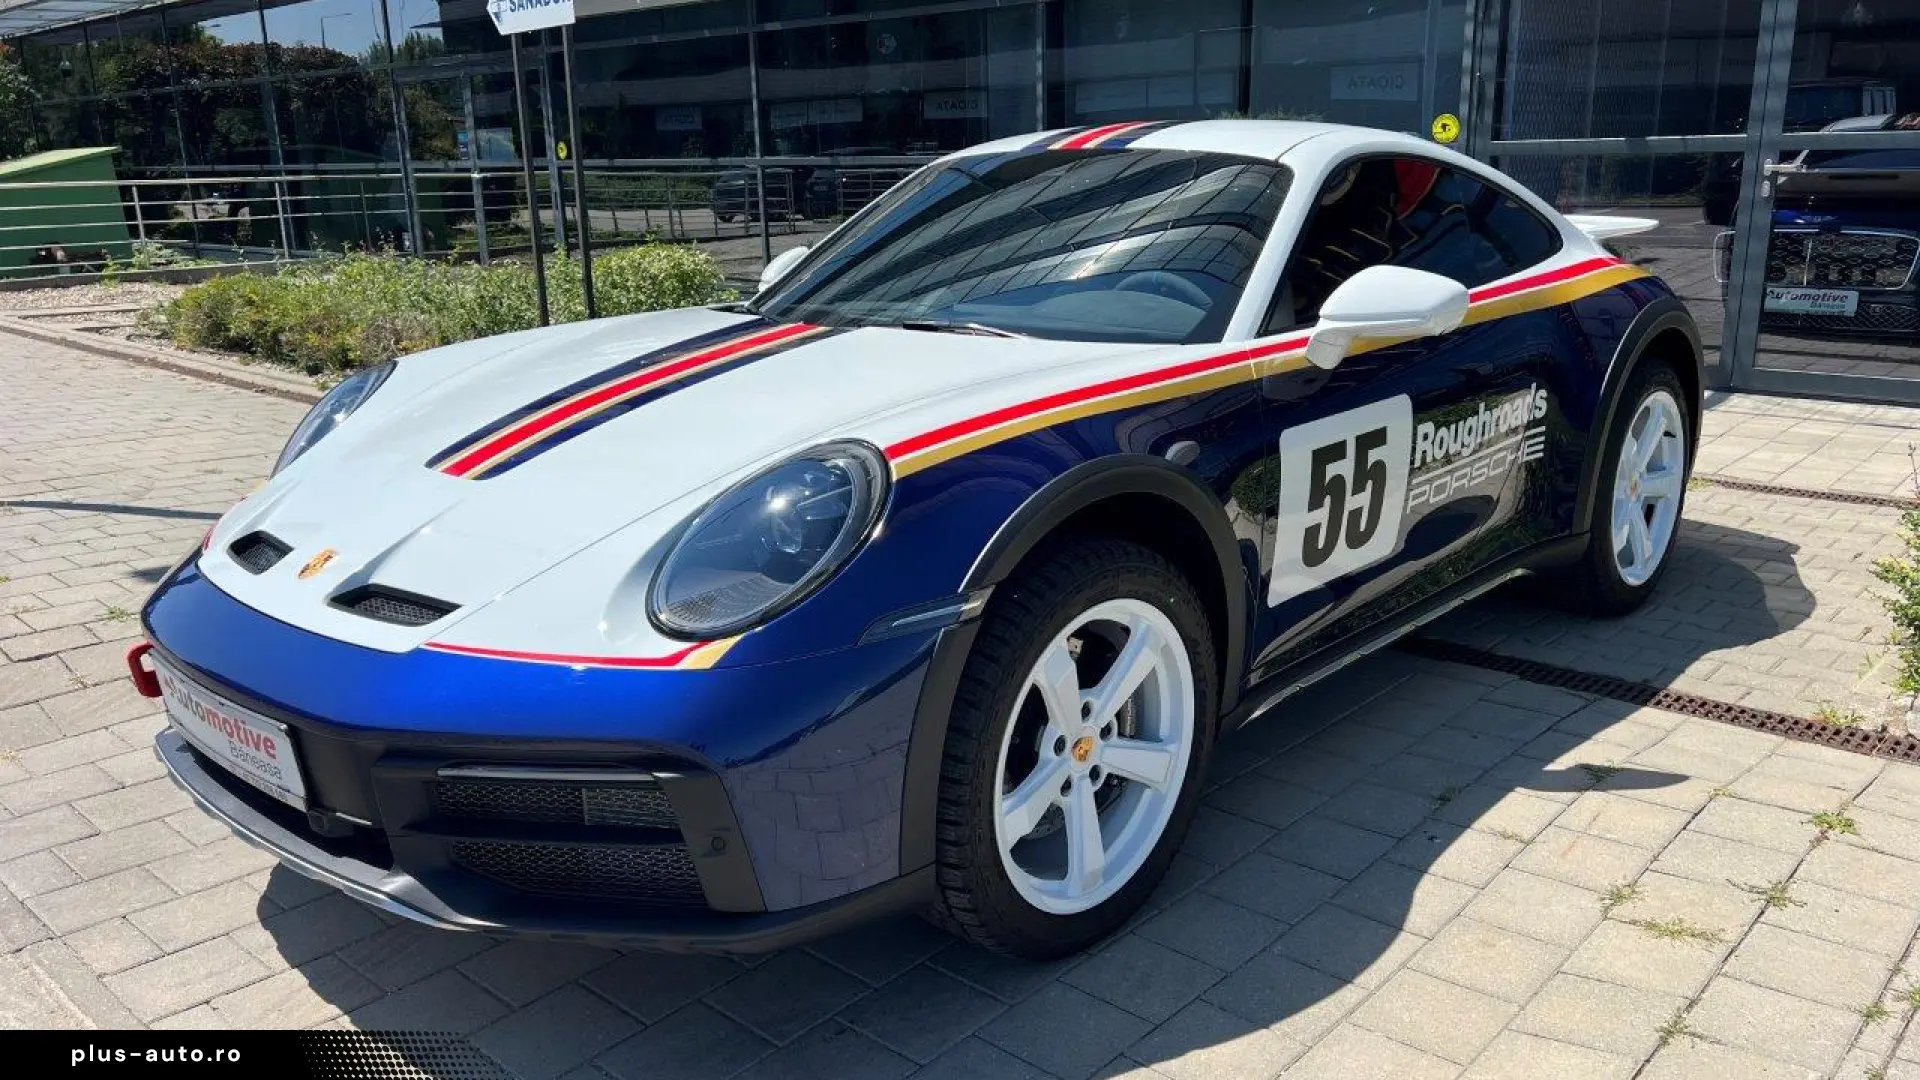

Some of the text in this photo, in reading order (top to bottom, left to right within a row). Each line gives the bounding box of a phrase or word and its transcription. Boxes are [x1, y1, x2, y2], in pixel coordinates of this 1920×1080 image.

[509, 0, 572, 12] SANAD
[1764, 289, 1849, 302] Automotive
[1413, 382, 1548, 469] Roughroads
[1301, 426, 1388, 568] 55
[1406, 435, 1546, 514] PORSCHE
[163, 674, 277, 760] Automotive
